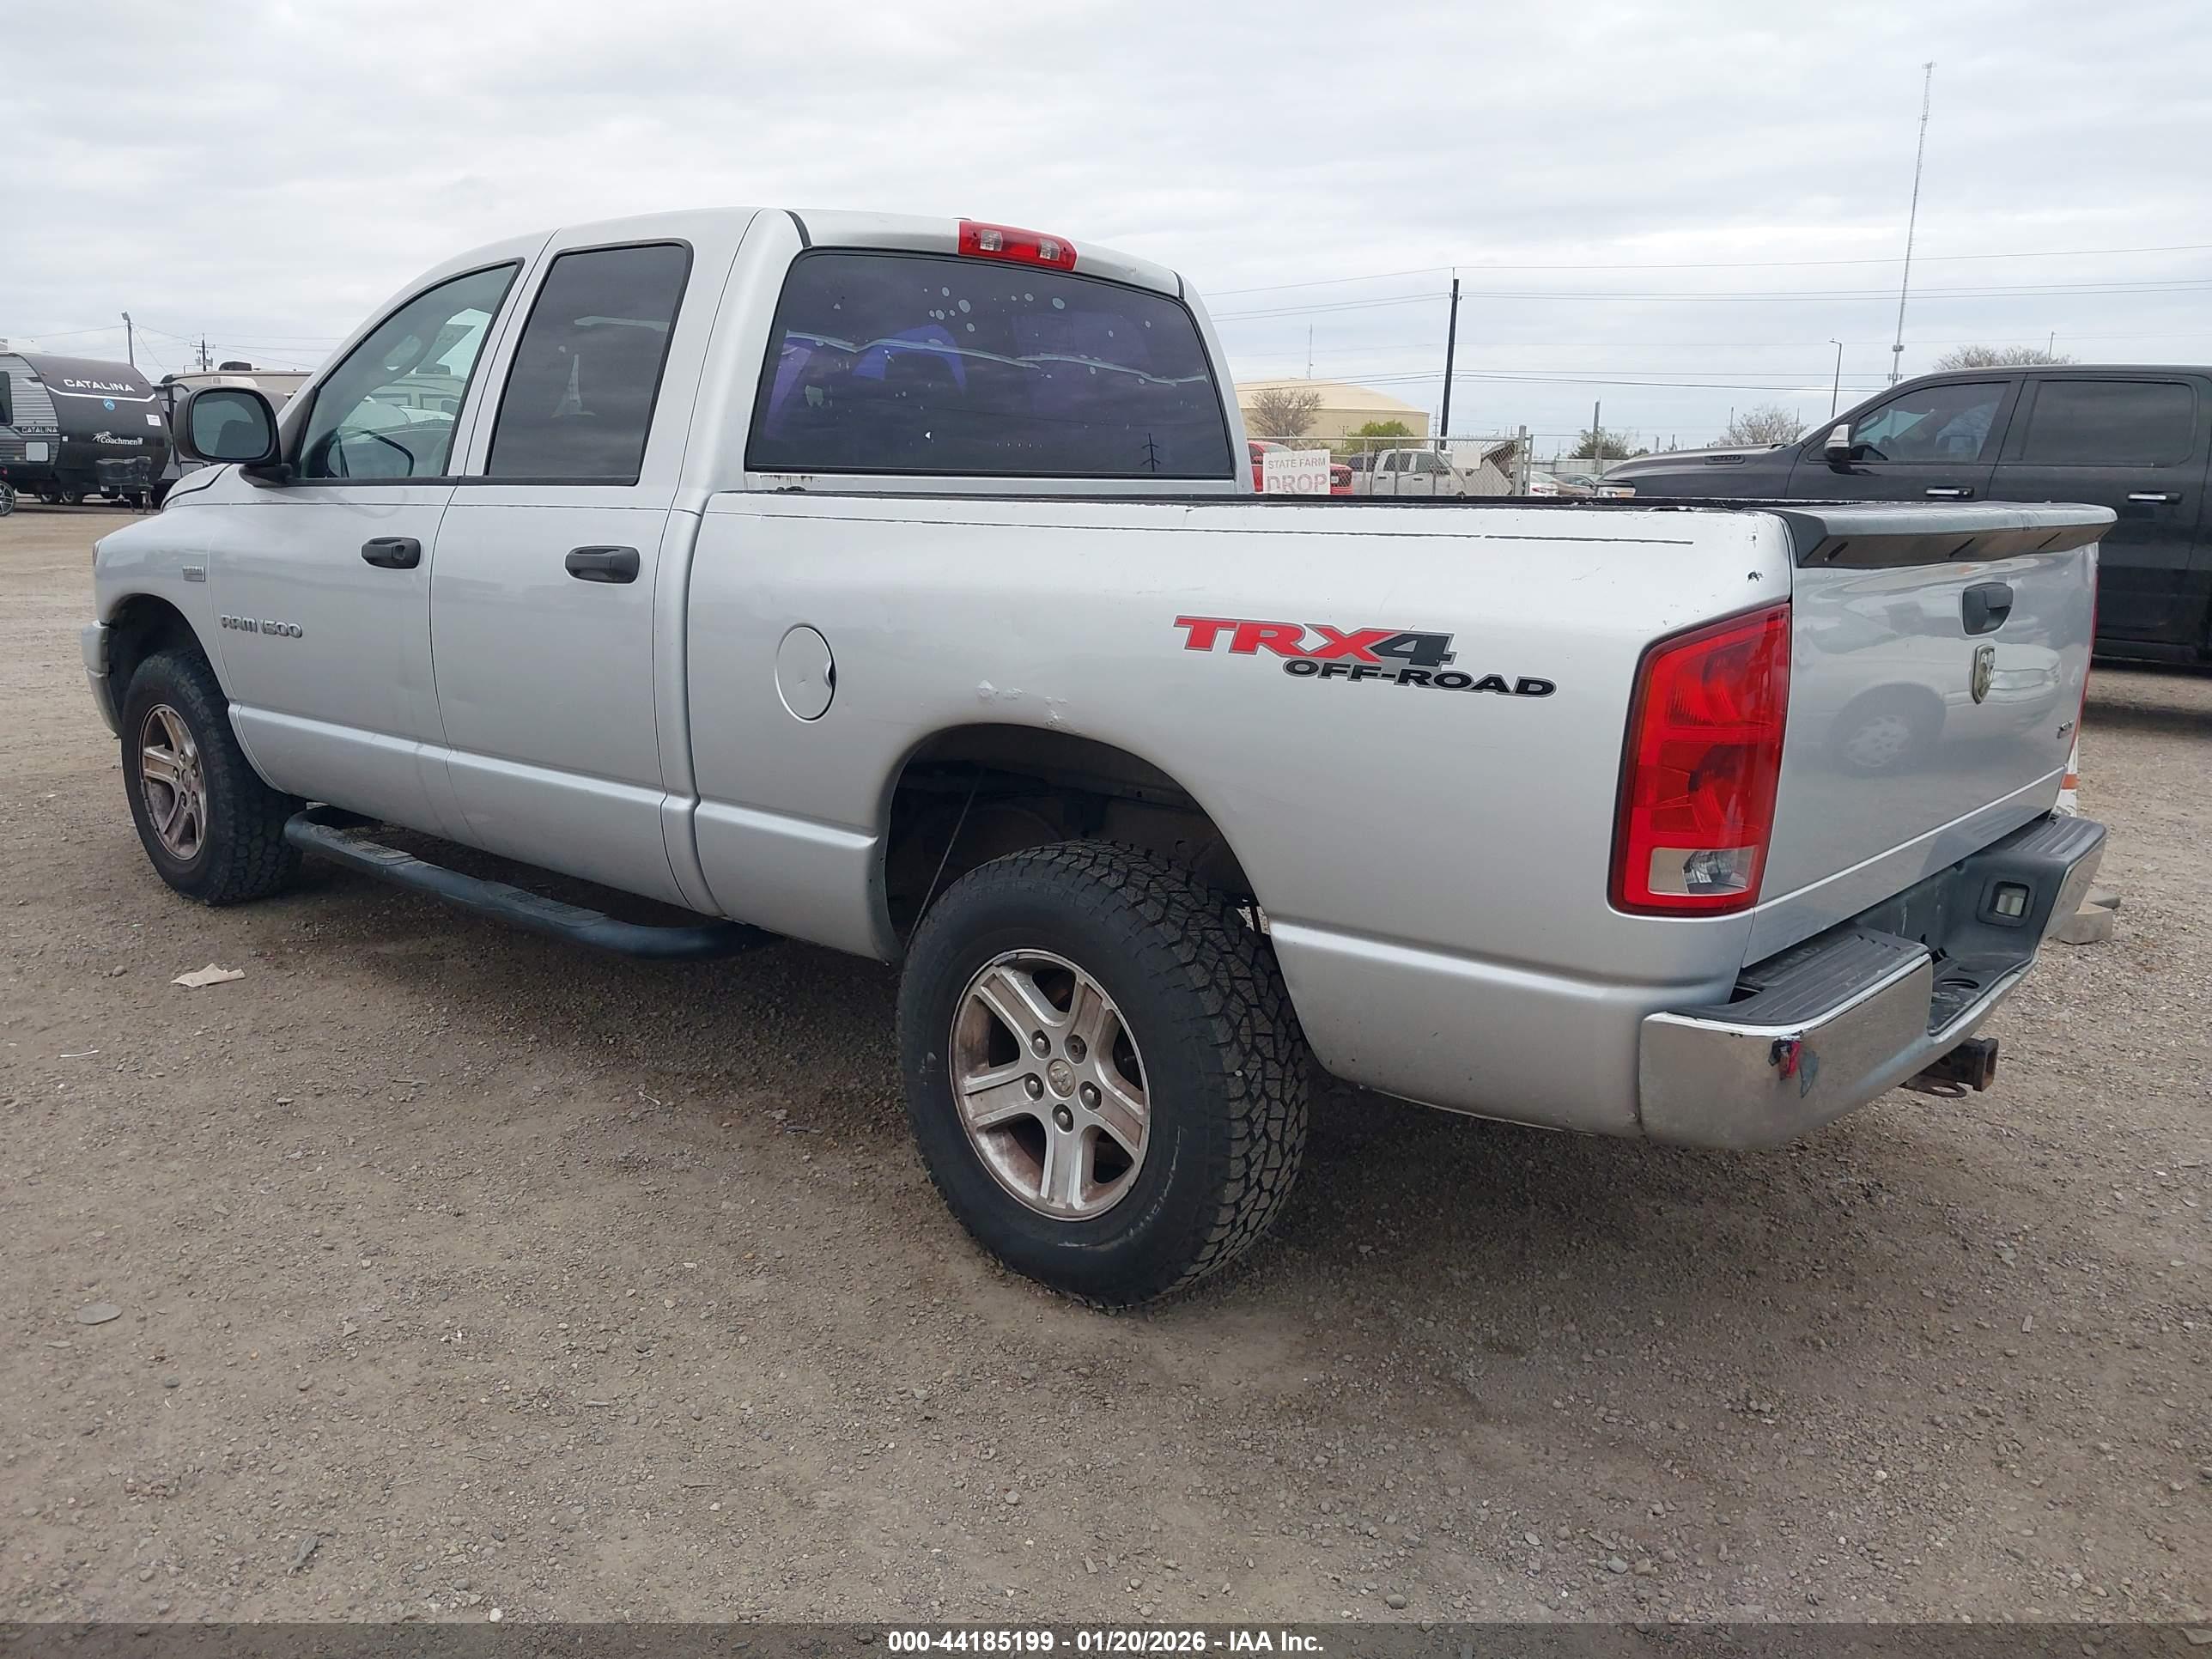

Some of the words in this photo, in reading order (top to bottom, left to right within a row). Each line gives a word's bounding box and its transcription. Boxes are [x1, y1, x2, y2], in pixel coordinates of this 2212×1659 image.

[63, 379, 136, 392] CATALINA
[100, 436, 137, 446] Coachmen
[1268, 459, 1297, 469] STATE
[1299, 457, 1326, 468] FARM
[1267, 473, 1328, 493] DROP
[221, 614, 258, 634] RAM
[261, 618, 303, 639] 1500
[1173, 616, 1457, 666] TRX4
[1284, 658, 1557, 697] OFF-ROAD
